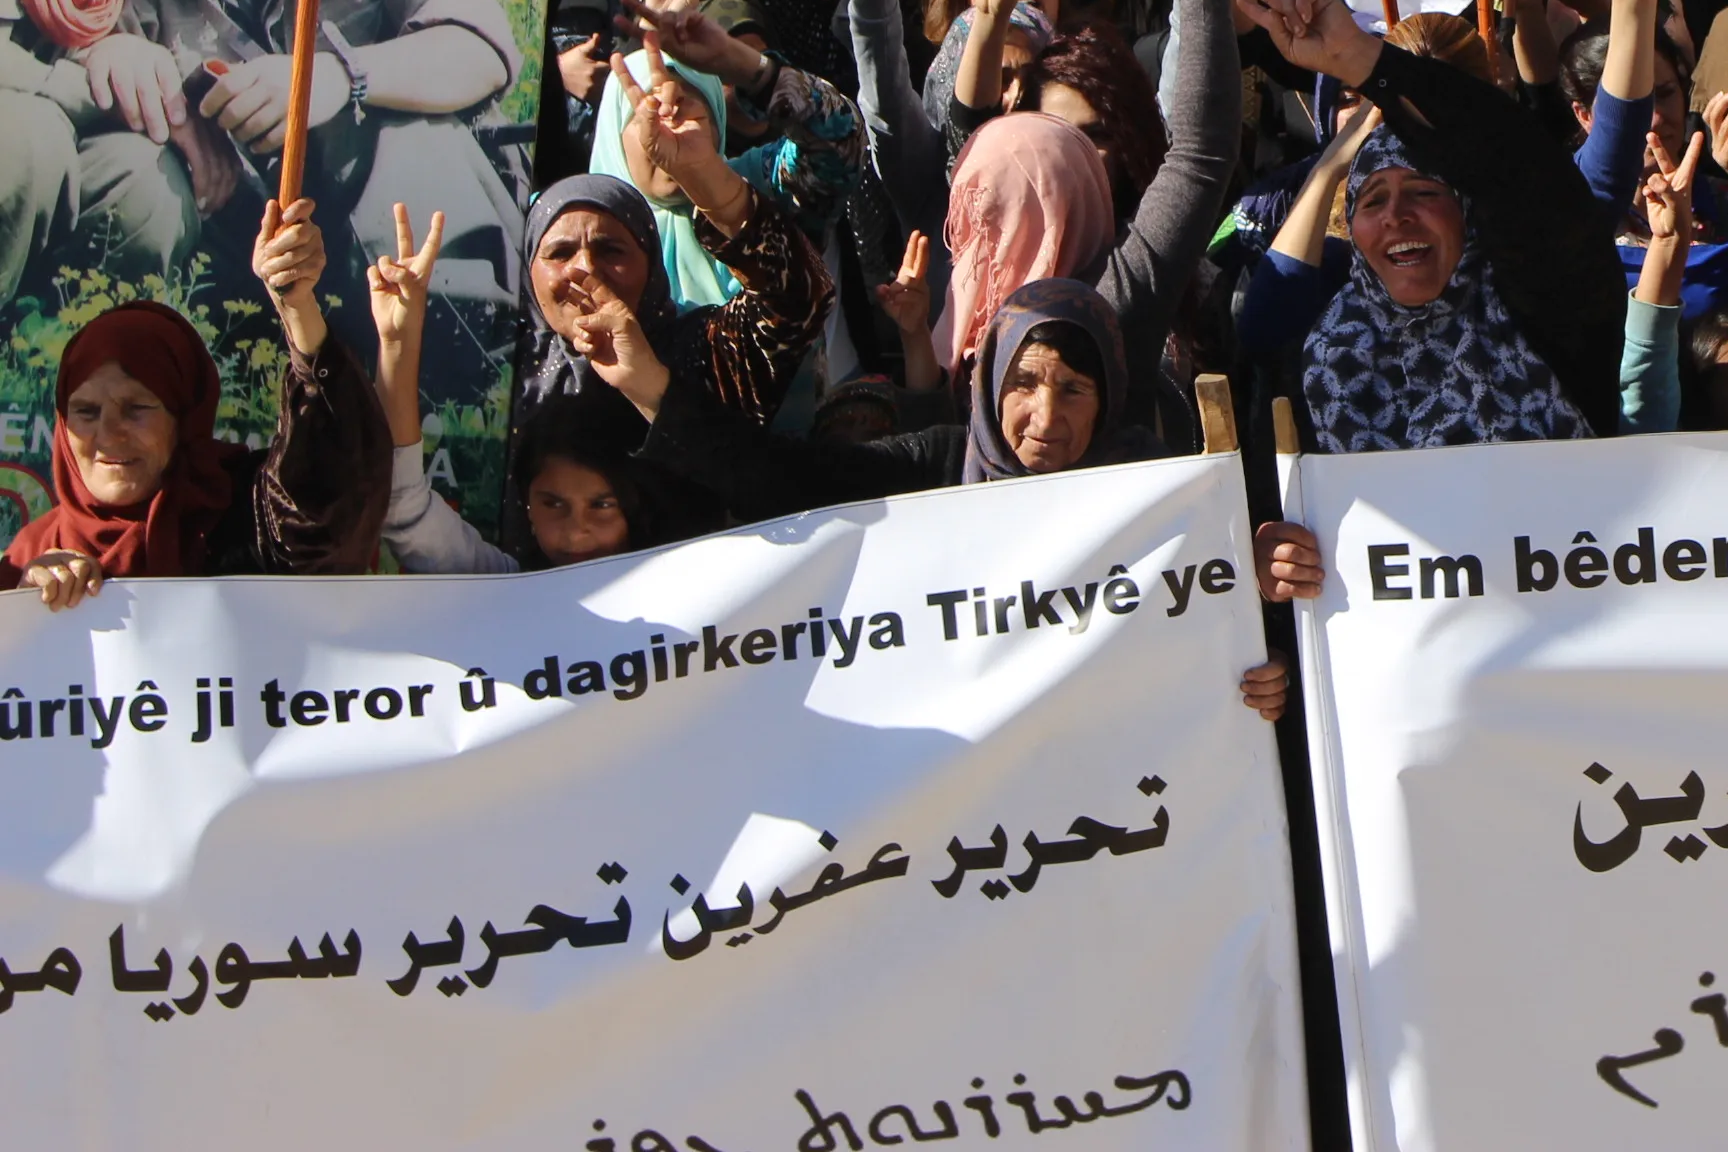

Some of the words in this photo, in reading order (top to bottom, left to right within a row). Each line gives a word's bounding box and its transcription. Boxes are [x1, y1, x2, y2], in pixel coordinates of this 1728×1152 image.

[1367, 543, 1484, 600] Em
[191, 677, 235, 743] ji
[260, 678, 434, 728] teror
[459, 667, 496, 712] û
[523, 607, 905, 701] dagirkeriya
[926, 564, 1140, 641] Tirkyê
[1161, 558, 1236, 618] ye
[662, 829, 911, 961] عفرين
[931, 774, 1170, 901] تحرير
[108, 923, 362, 1022] سوريا
[386, 861, 632, 998] تحرير
